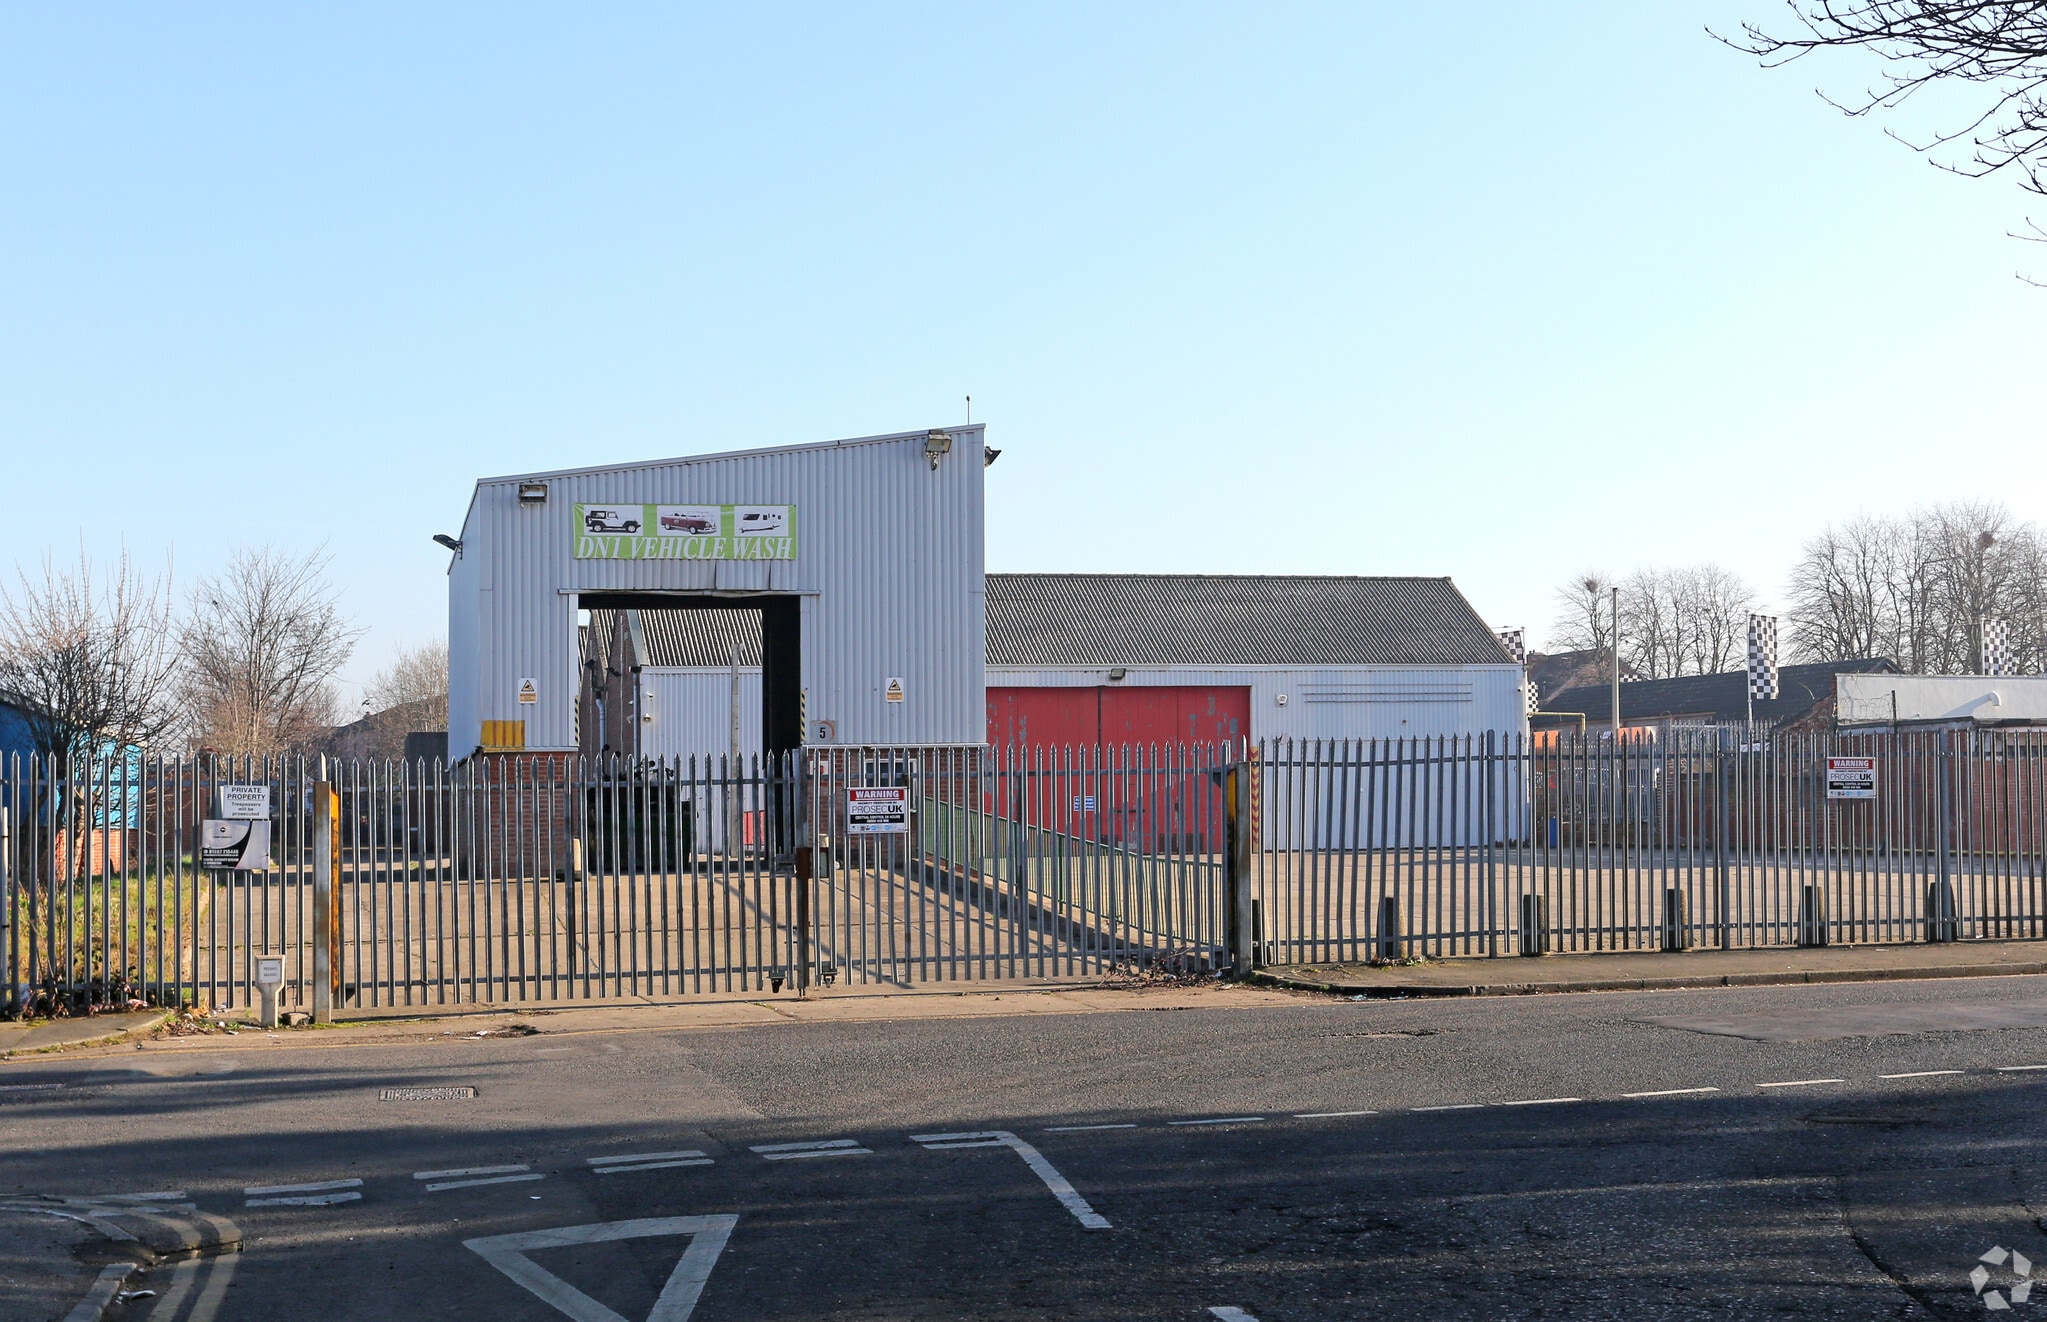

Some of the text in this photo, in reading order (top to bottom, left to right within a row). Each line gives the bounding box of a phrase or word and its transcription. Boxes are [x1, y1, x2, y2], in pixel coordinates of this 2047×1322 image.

[577, 537, 793, 559] DN1 VEHICLE WASH
[819, 727, 826, 738] 5
[855, 790, 899, 798] WARNING
[852, 805, 902, 813] PROSECUK
